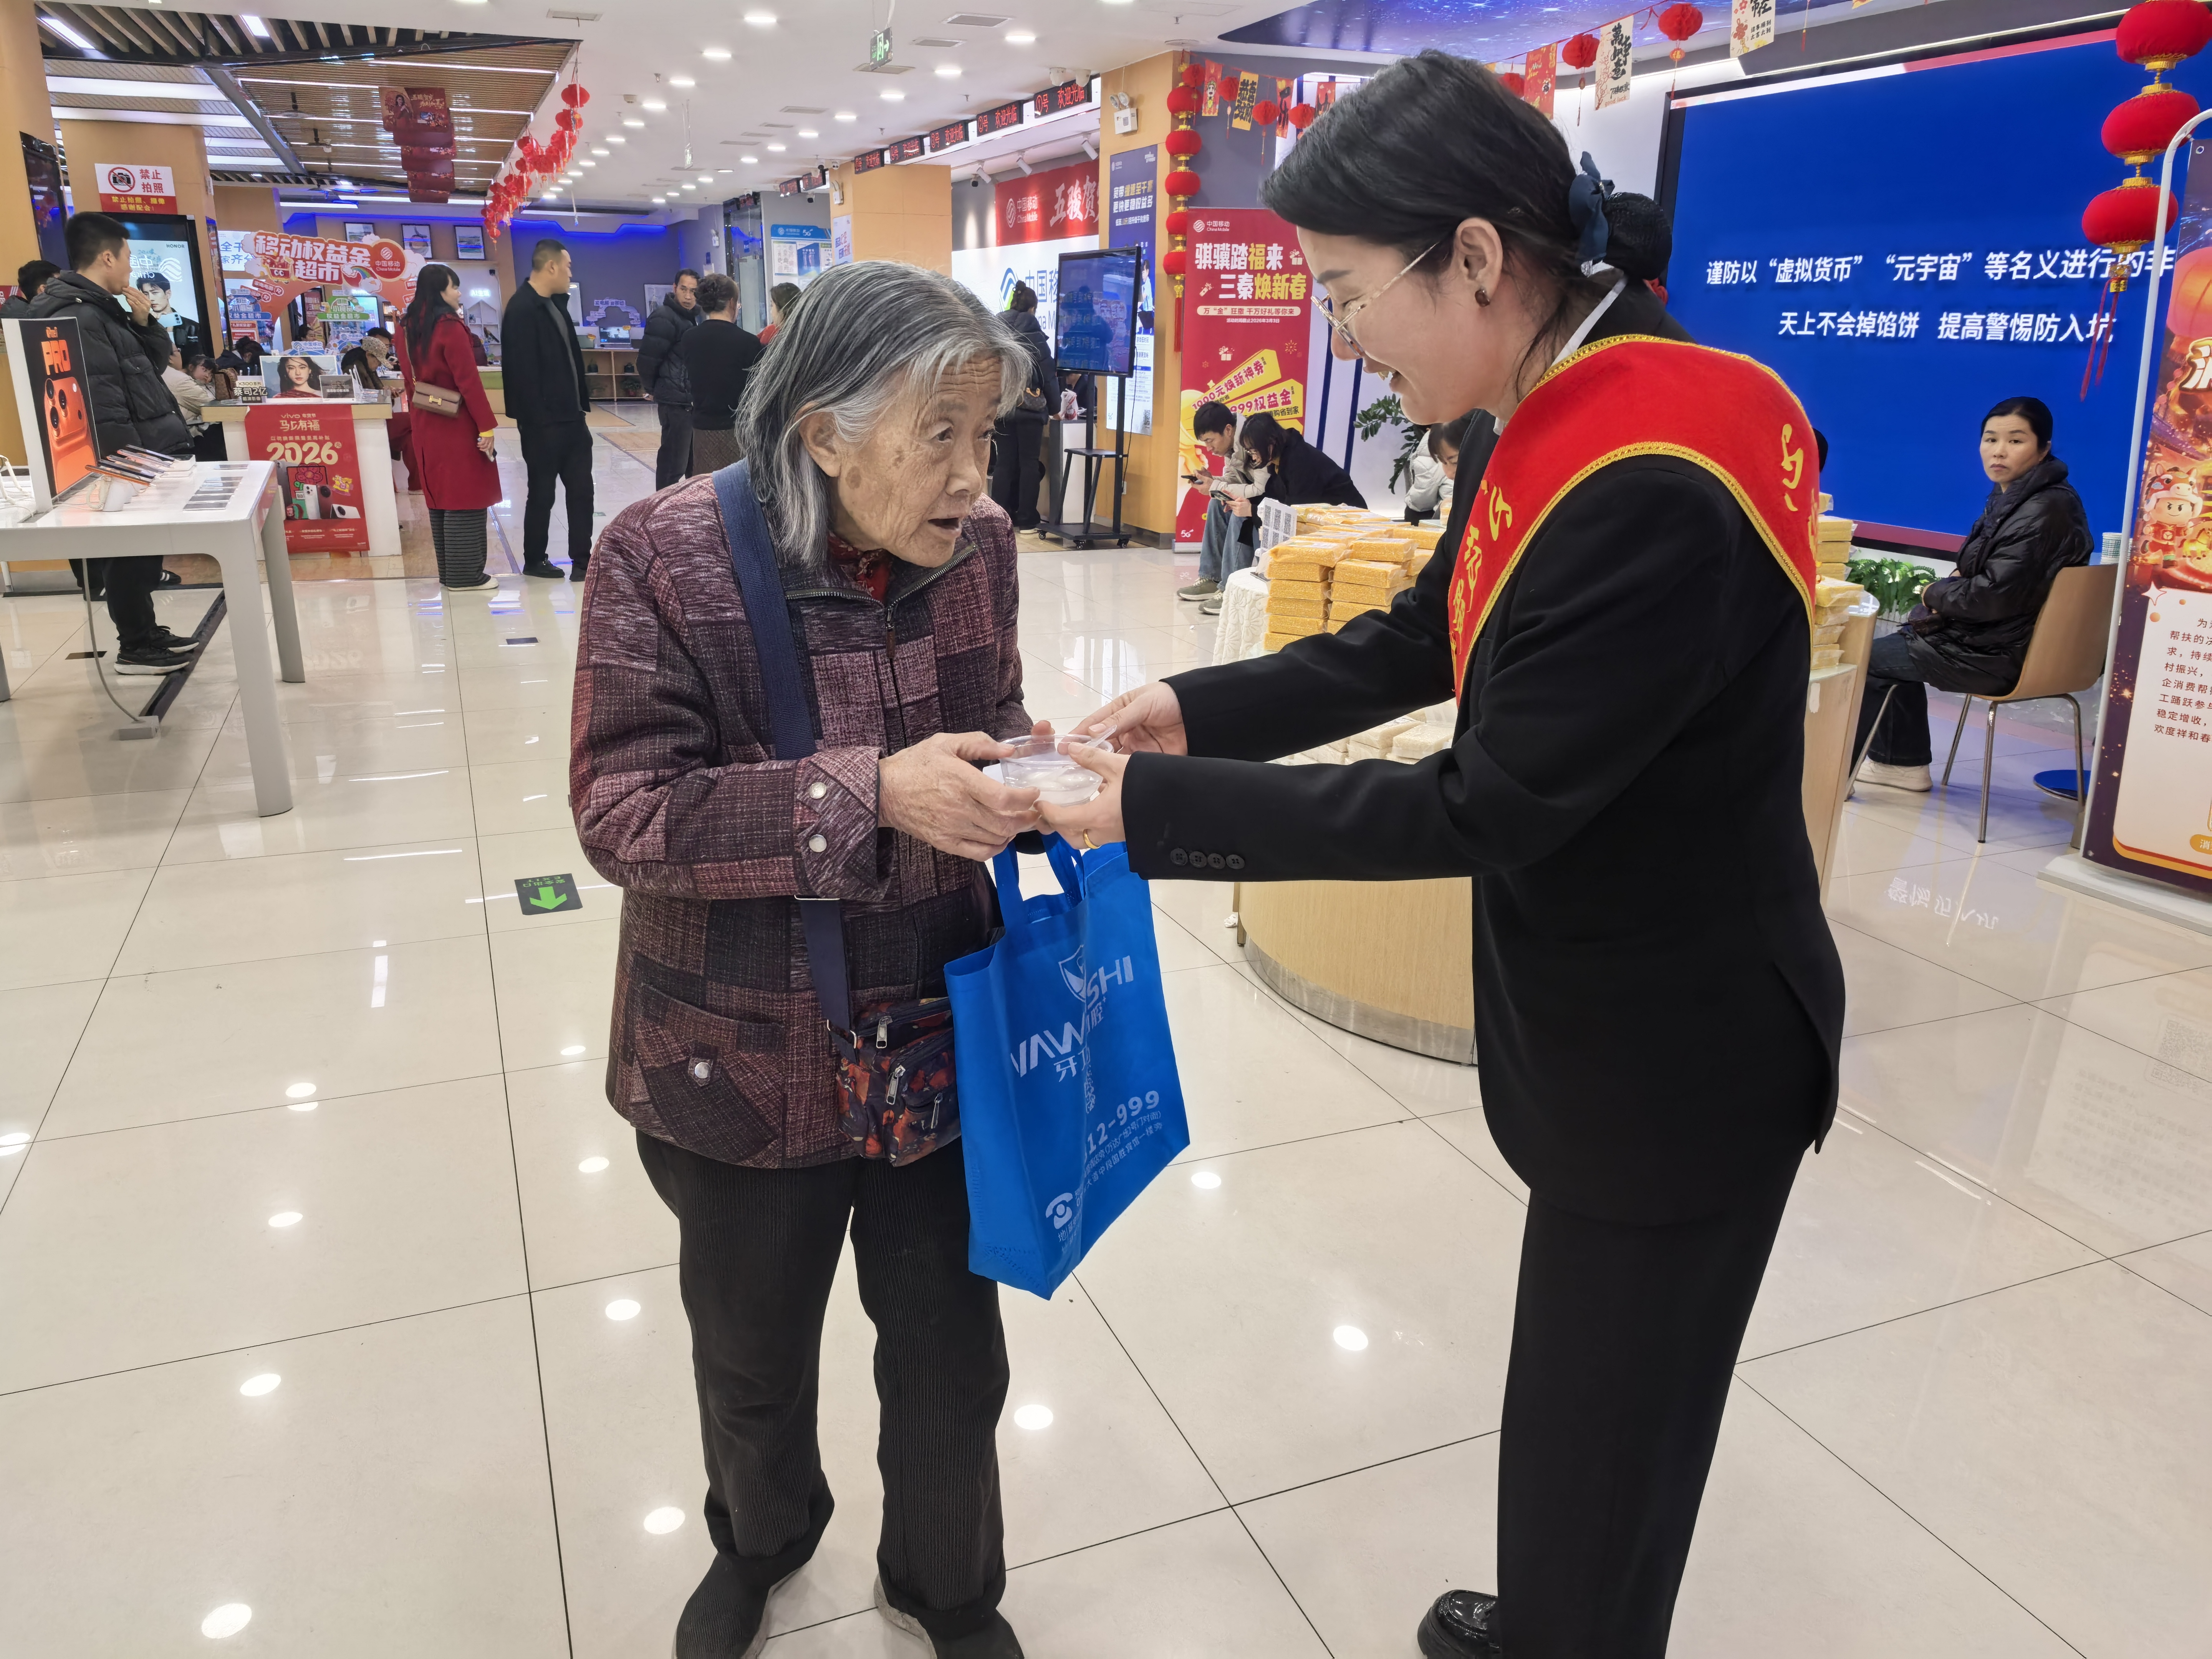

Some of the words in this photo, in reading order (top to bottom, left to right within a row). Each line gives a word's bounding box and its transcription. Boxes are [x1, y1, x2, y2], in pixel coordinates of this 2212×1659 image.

[1058, 83, 1084, 108] 欢迎光临
[995, 104, 1017, 129] 欢迎光临
[139, 169, 162, 180] 禁止
[141, 182, 164, 194] 拍照
[1017, 195, 1038, 212] 中国移动
[255, 234, 371, 267] 移动权益金
[1195, 243, 1283, 271] 骐骥踏福来
[295, 260, 340, 282] 超市
[1705, 260, 1758, 285] 谨防以
[1769, 255, 1863, 282] “虚拟货币”
[1886, 252, 1973, 281] “元宇宙”
[1219, 272, 1306, 300] 三秦焕新春
[1778, 311, 1919, 338] 天上不会掉馅饼
[1937, 312, 2116, 343] 提高警惕防入坑
[41, 339, 71, 375] PRO
[233, 387, 268, 396] 蔡司2亿
[1192, 359, 1265, 410] 1000元焕新神券
[267, 442, 339, 465] 2026
[1181, 529, 1194, 538] 5G
[1084, 1090, 1159, 1164] 12-999
